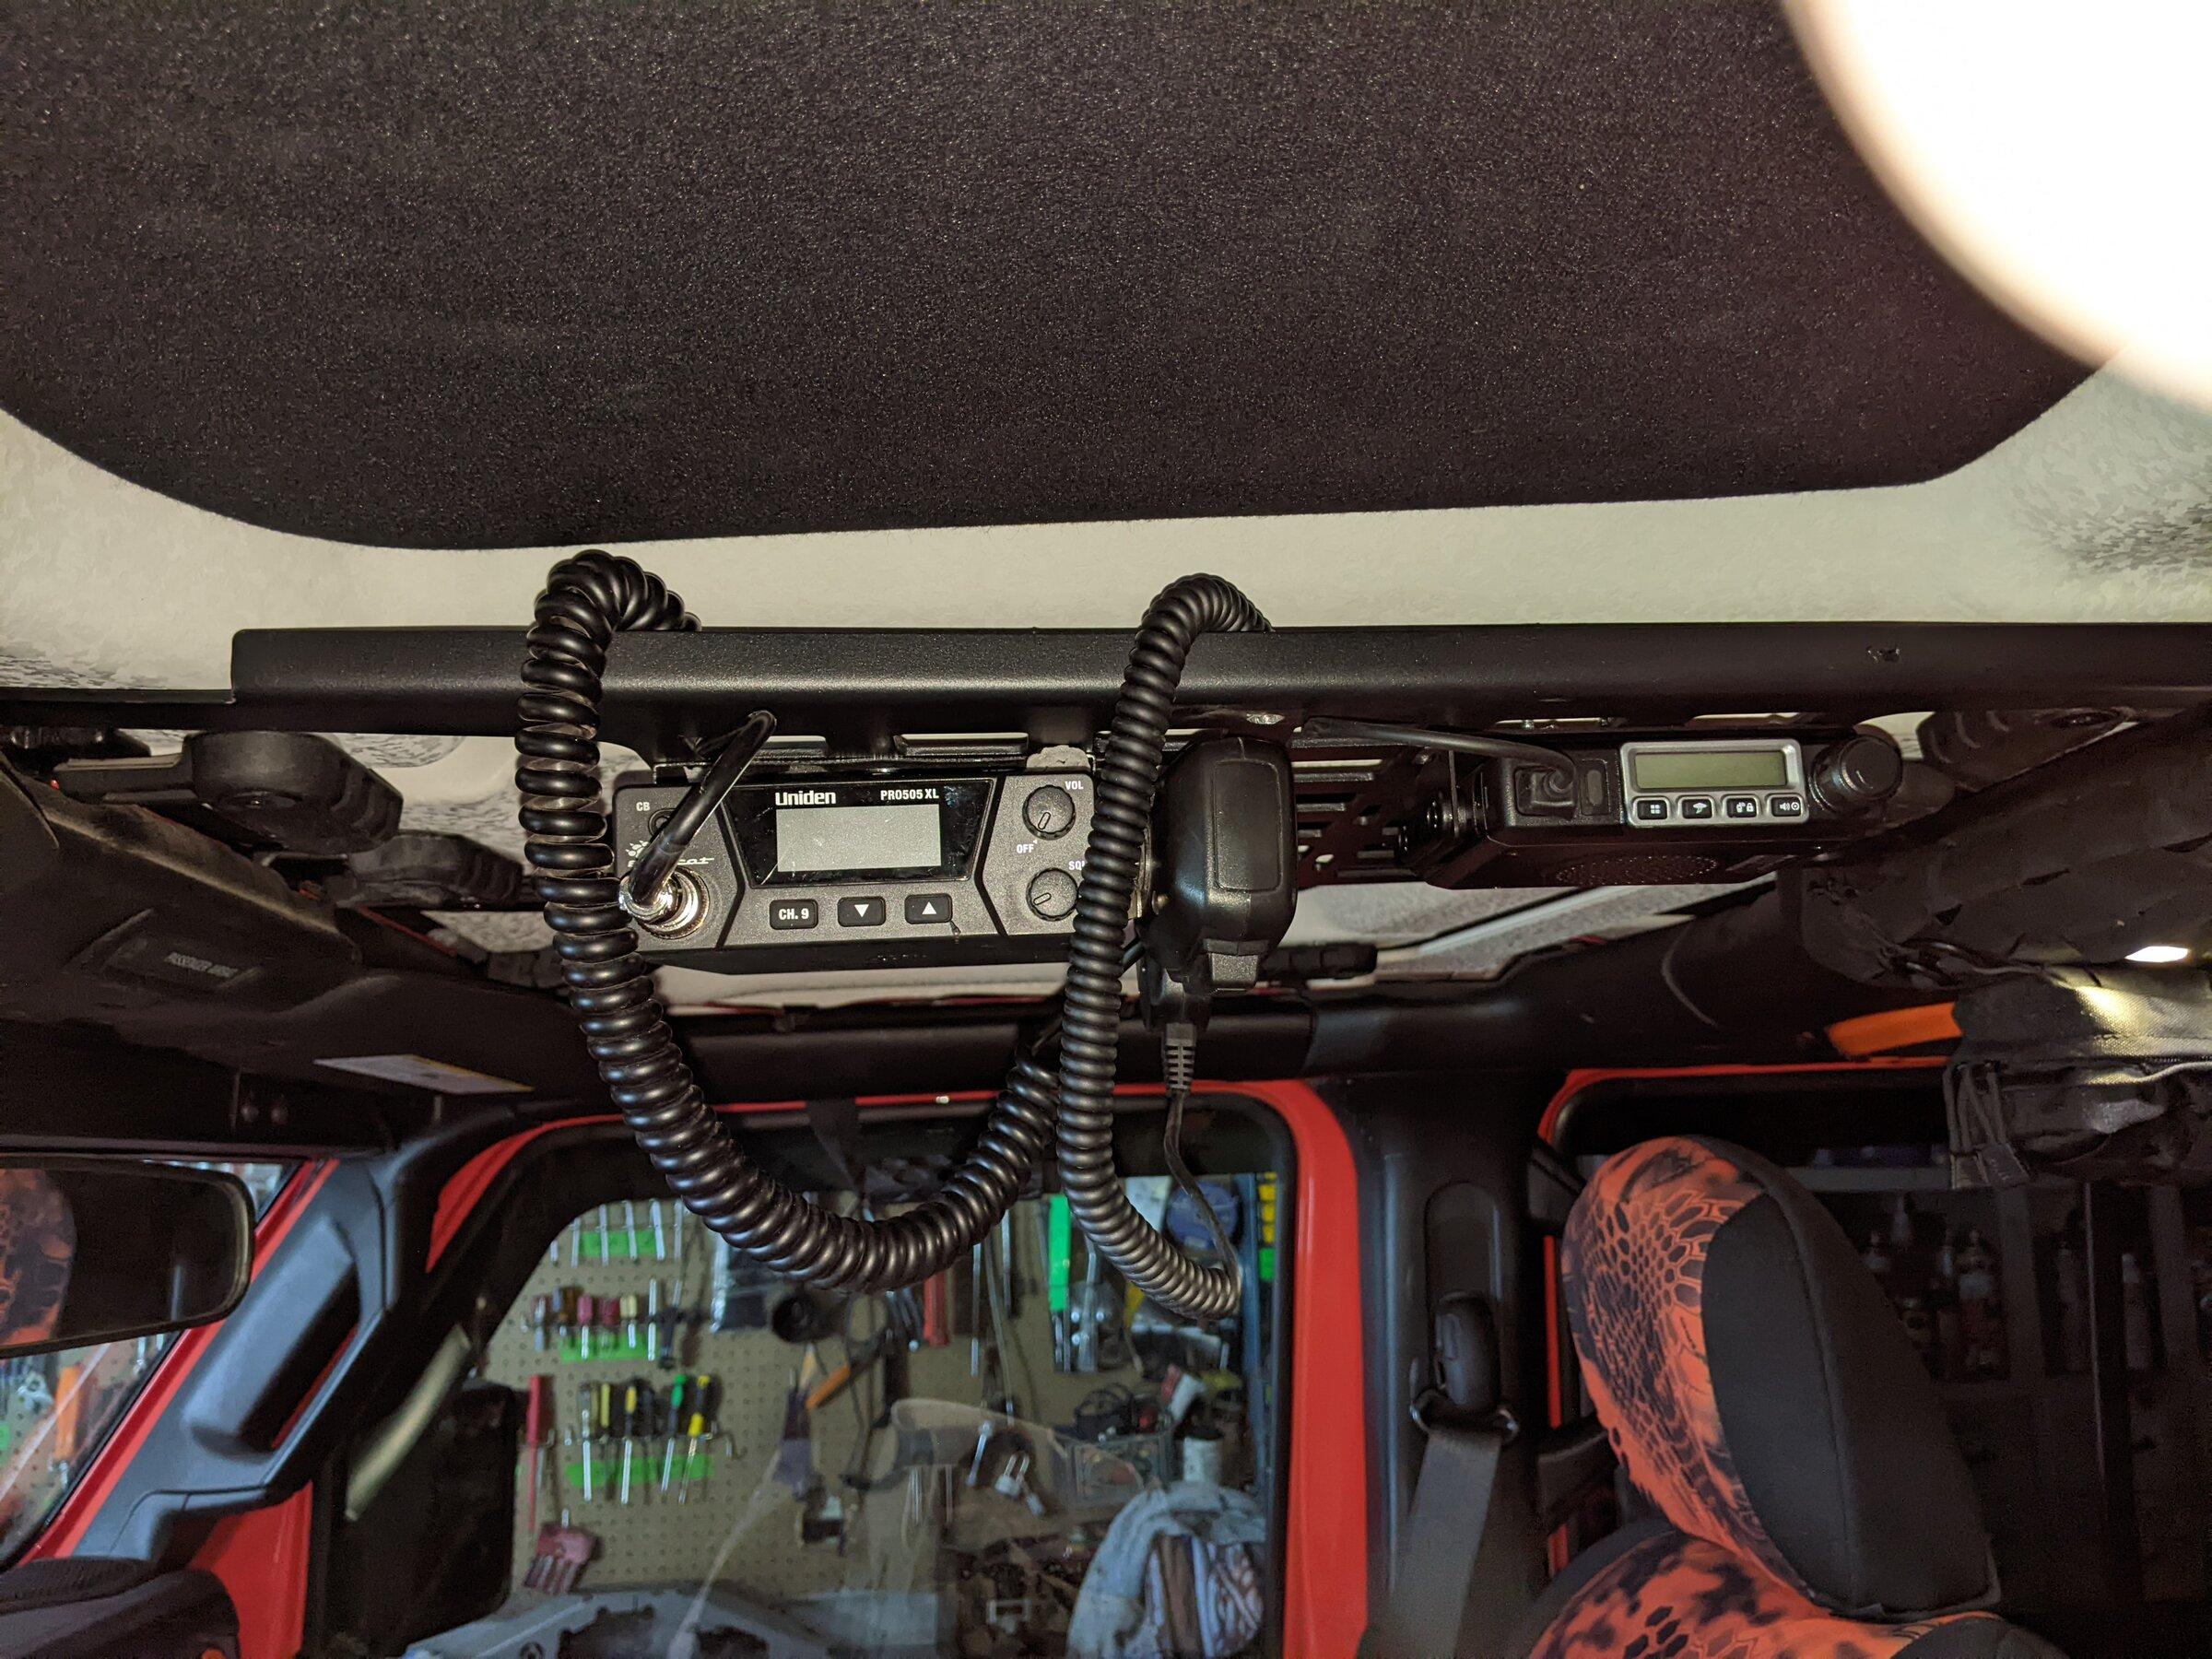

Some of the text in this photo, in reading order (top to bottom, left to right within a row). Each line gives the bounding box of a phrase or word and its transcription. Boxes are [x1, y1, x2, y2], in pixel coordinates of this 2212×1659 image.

[1065, 781, 1084, 790] VOL
[775, 791, 836, 806] Uniden
[881, 788, 939, 800] PRO505 XL
[636, 802, 650, 811] CB
[1017, 844, 1033, 854] OFF
[779, 908, 809, 920] CH. 9
